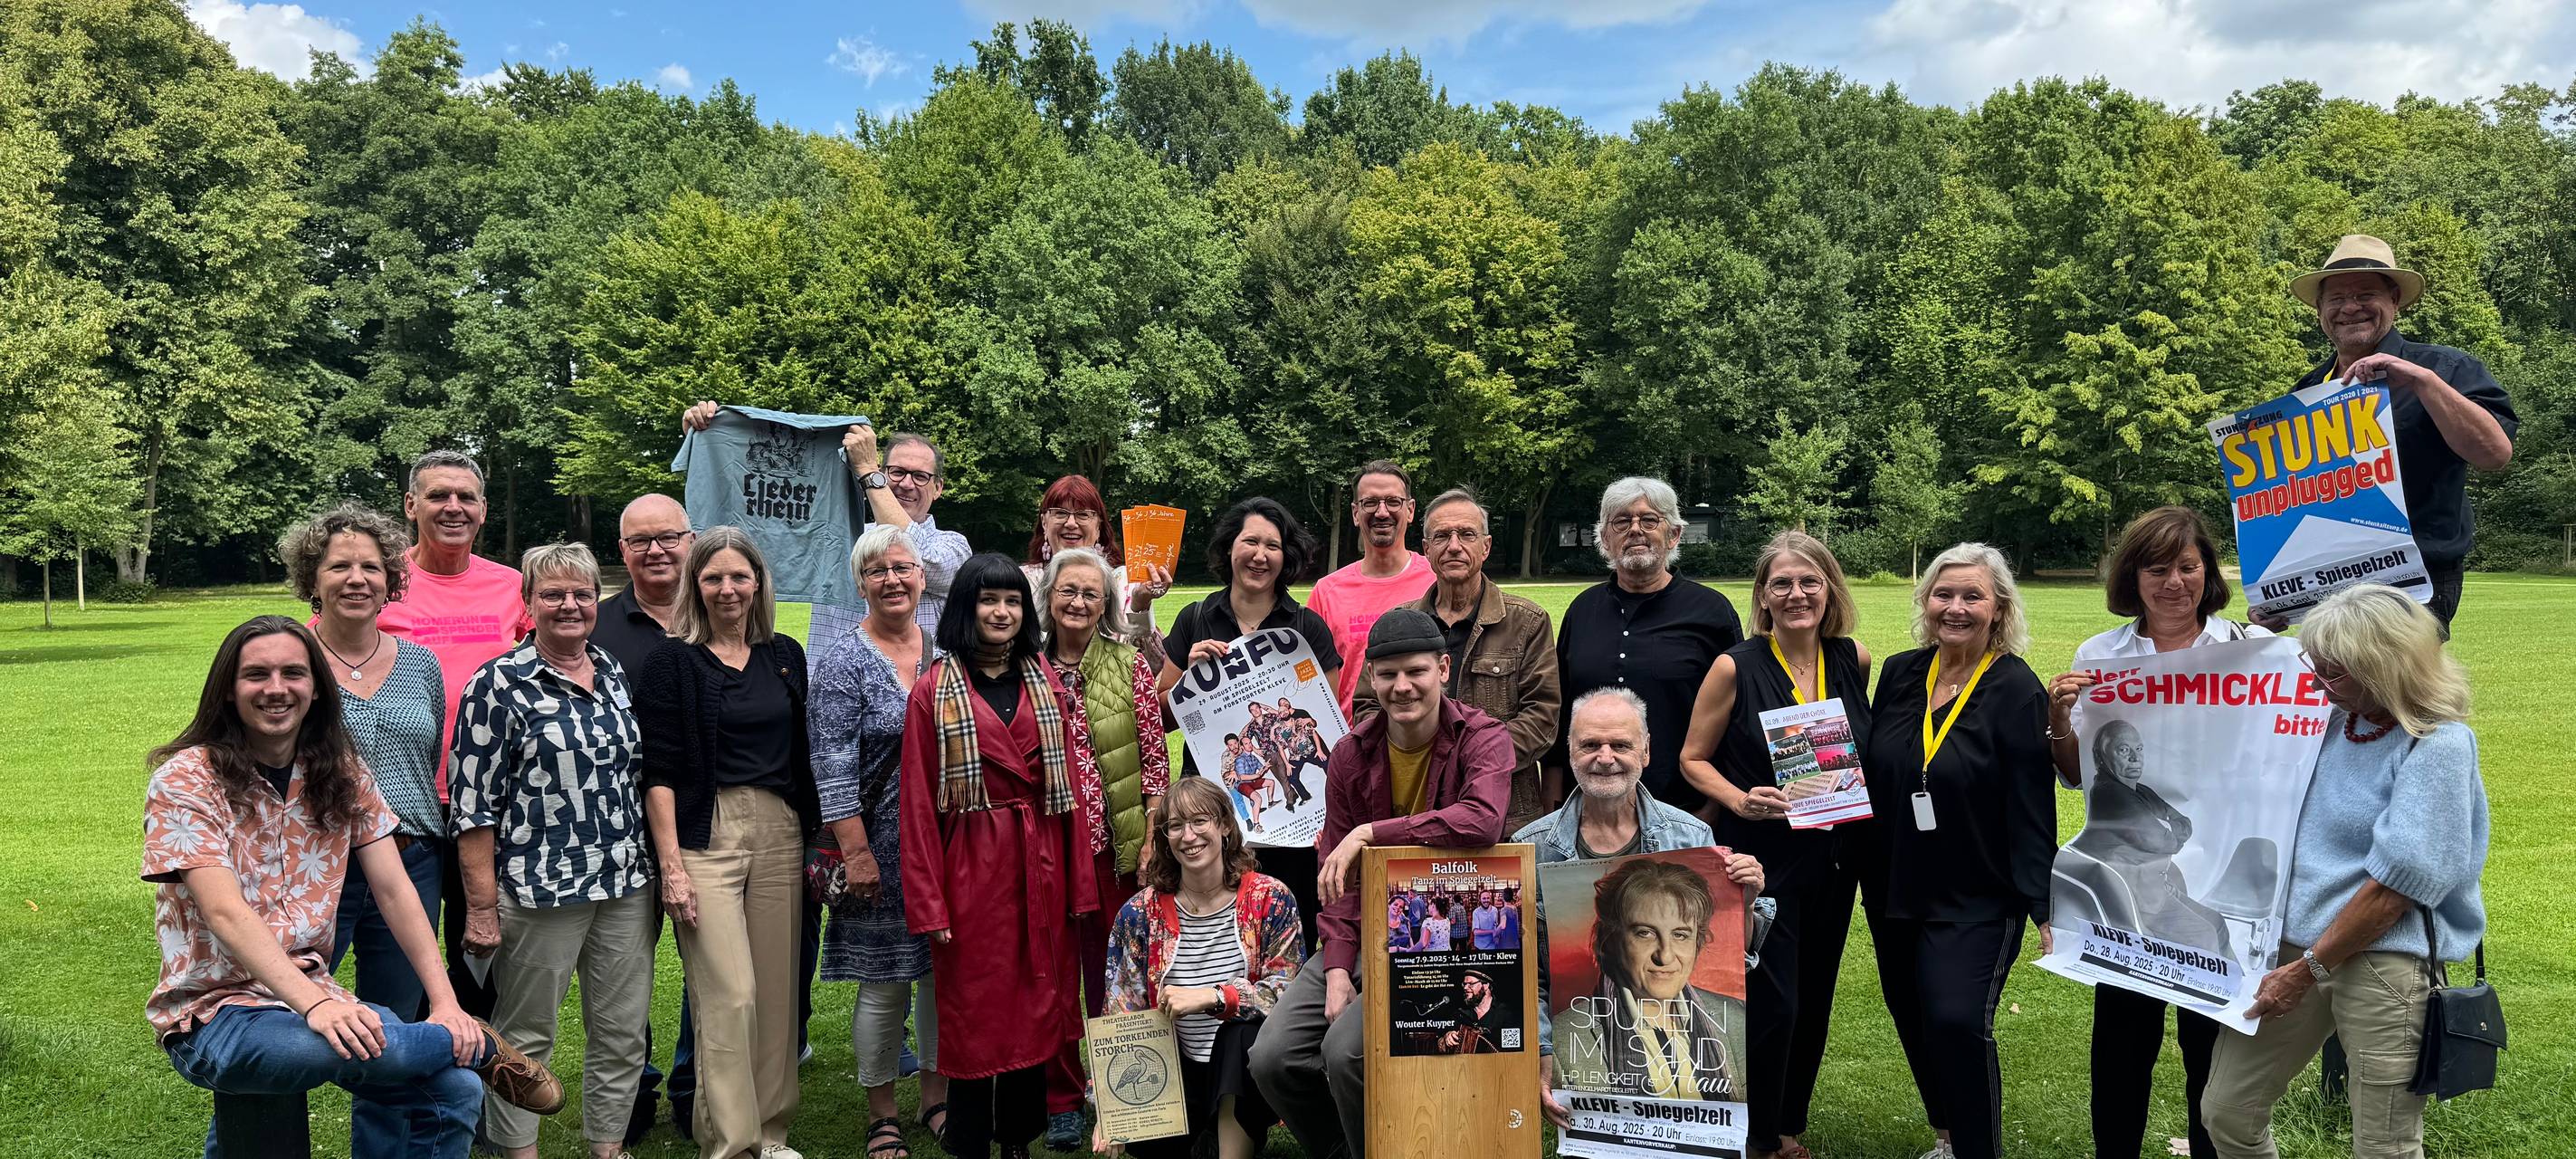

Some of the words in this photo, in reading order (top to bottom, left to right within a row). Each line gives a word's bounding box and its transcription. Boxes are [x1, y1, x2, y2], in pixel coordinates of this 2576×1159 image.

[2323, 396, 2340, 406] TOUR
[2340, 391, 2355, 401] 2020
[2361, 386, 2378, 396] 2021
[2222, 393, 2390, 488] STUNK
[743, 472, 817, 503] Lieder
[2236, 448, 2397, 522] unplugged
[746, 498, 812, 525] rhein
[2350, 517, 2409, 532] www.stunksitzung.de
[2261, 576, 2306, 600] KLEVE
[2314, 550, 2409, 586] Spiegelzelt
[411, 615, 480, 627] HOMERUN
[440, 620, 501, 634] SPENDEN
[1209, 685, 1232, 700] AUGUST
[1234, 680, 1250, 689] 2025
[1277, 660, 1290, 669] UHR
[2085, 666, 2141, 685] Herr
[1224, 687, 1266, 709] FORSTGARTEN
[1267, 677, 1287, 689] KLEVE
[1231, 677, 1271, 698] SPIEGELZELT
[1782, 714, 1798, 723] ABEND
[1805, 795, 1836, 806] SPIEGELZELT
[1431, 860, 1477, 874] Balfolk
[1411, 876, 1434, 885] Tanz
[1436, 876, 1447, 885] im
[1449, 874, 1497, 886] Spiegelzelt
[1415, 955, 1446, 963] 7.9.2025
[1469, 953, 1477, 962] 17
[2090, 922, 2132, 947] KLEVE
[2141, 936, 2228, 977] Spiegelzelt
[2084, 940, 2098, 955] Do.,
[2100, 945, 2112, 959] 28.
[2113, 950, 2132, 966] Aug.
[2133, 956, 2154, 972] 2025
[2159, 964, 2170, 977] 20
[2171, 968, 2186, 982] Uhr
[2207, 982, 2222, 994] 19:00
[1102, 1014, 1145, 1025] THEATERLABOR
[1395, 1020, 1425, 1029] Wouter
[1426, 1020, 1455, 1029] Kuyper
[1569, 996, 1727, 1034] SPUREN
[1093, 1037, 1113, 1047] ZUM
[1114, 1029, 1169, 1043] TORKELNDEN
[1094, 1044, 1134, 1058] STORCH
[1569, 1031, 1603, 1065] IM
[1627, 1035, 1726, 1072] SAND
[1561, 1069, 1579, 1082] HP
[1582, 1070, 1642, 1086] LENGKEIT
[1640, 1058, 1733, 1097] Haui
[1611, 1087, 1639, 1095] BEGLEITET
[1570, 1097, 1620, 1114] KLEVE
[1632, 1100, 1732, 1126] Spiegelzelt
[1583, 1116, 1596, 1130] 30.
[1598, 1119, 1619, 1135] Aug.
[1623, 1122, 1645, 1135] 2025
[1652, 1125, 1664, 1138] 20
[1666, 1127, 1682, 1140] Uhr
[1685, 1133, 1707, 1144] Einlass:
[1709, 1135, 1725, 1146] 19:00
[1726, 1137, 1737, 1147] Uhr
